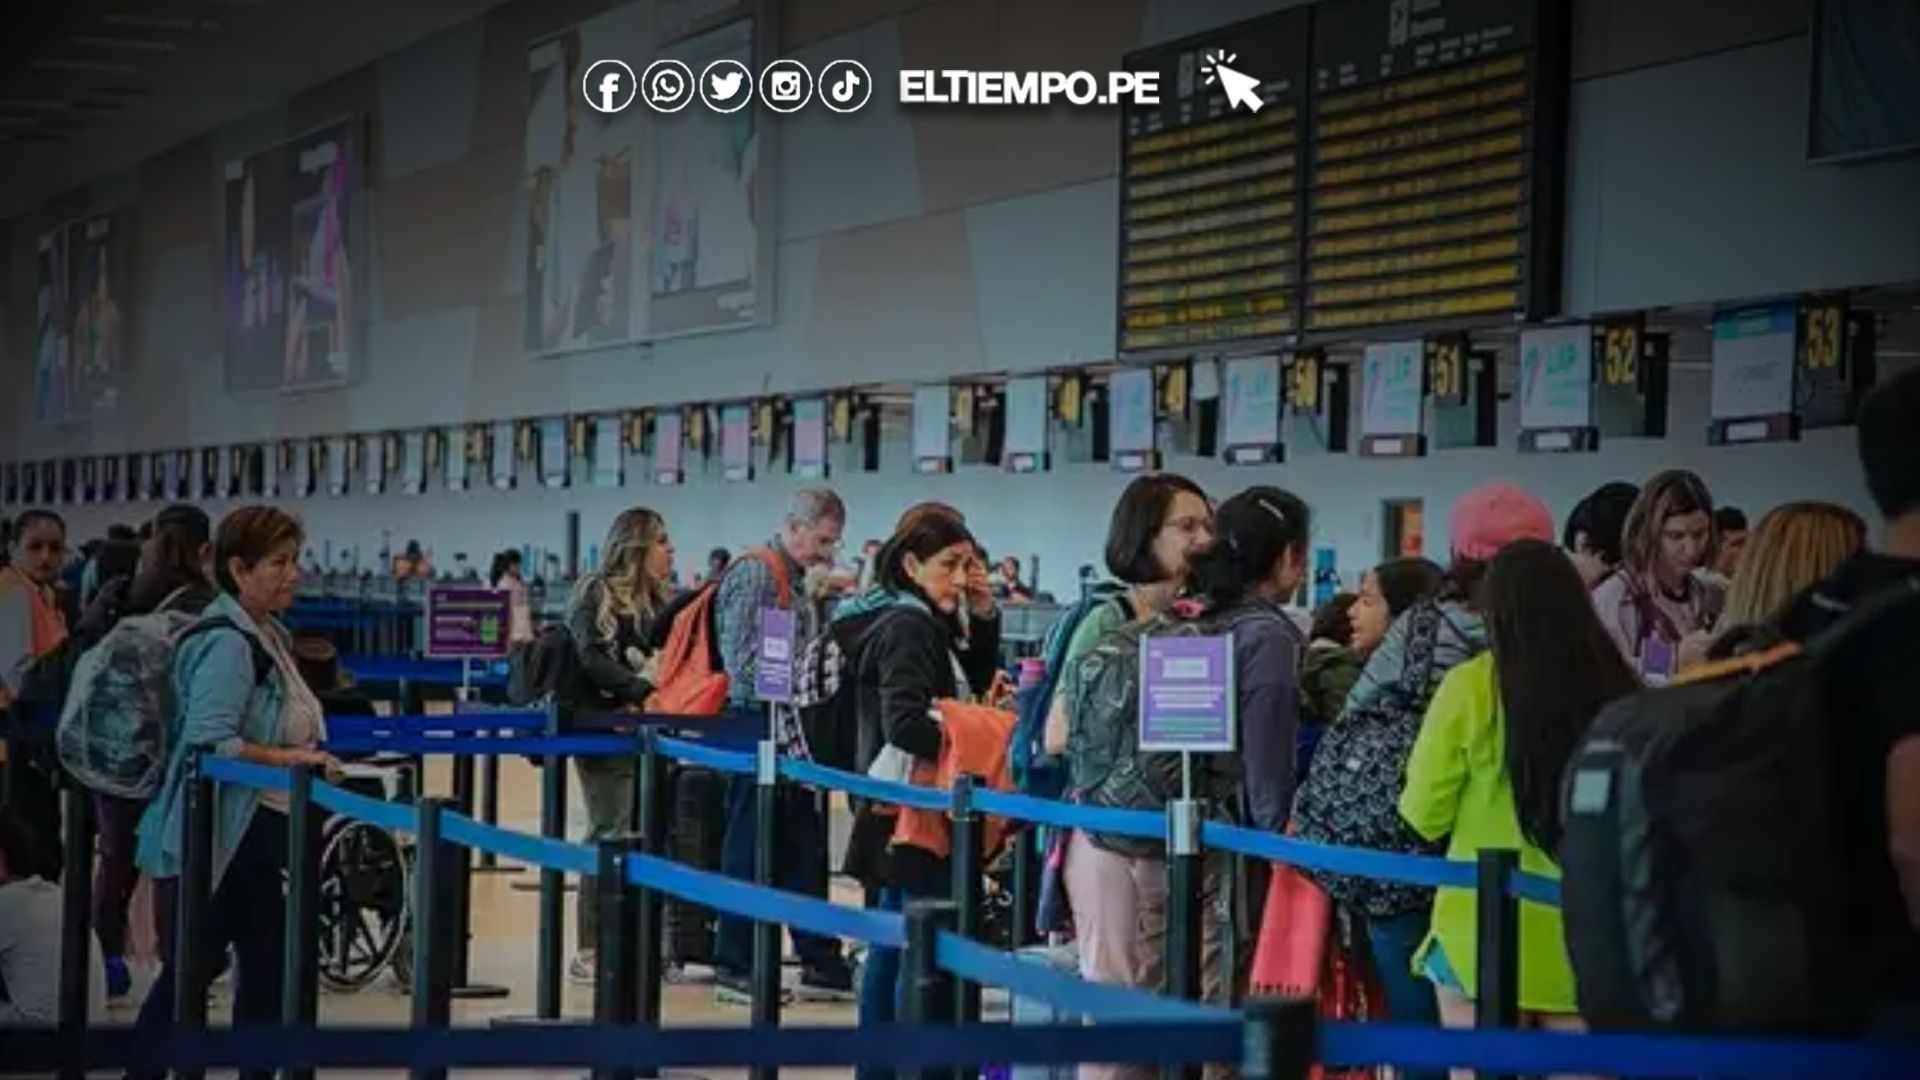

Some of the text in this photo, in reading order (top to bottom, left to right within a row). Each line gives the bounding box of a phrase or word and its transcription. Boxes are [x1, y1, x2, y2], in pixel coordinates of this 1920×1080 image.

[1605, 327, 1638, 385] 52
[1808, 306, 1840, 369] 53
[1434, 345, 1459, 396] 51
